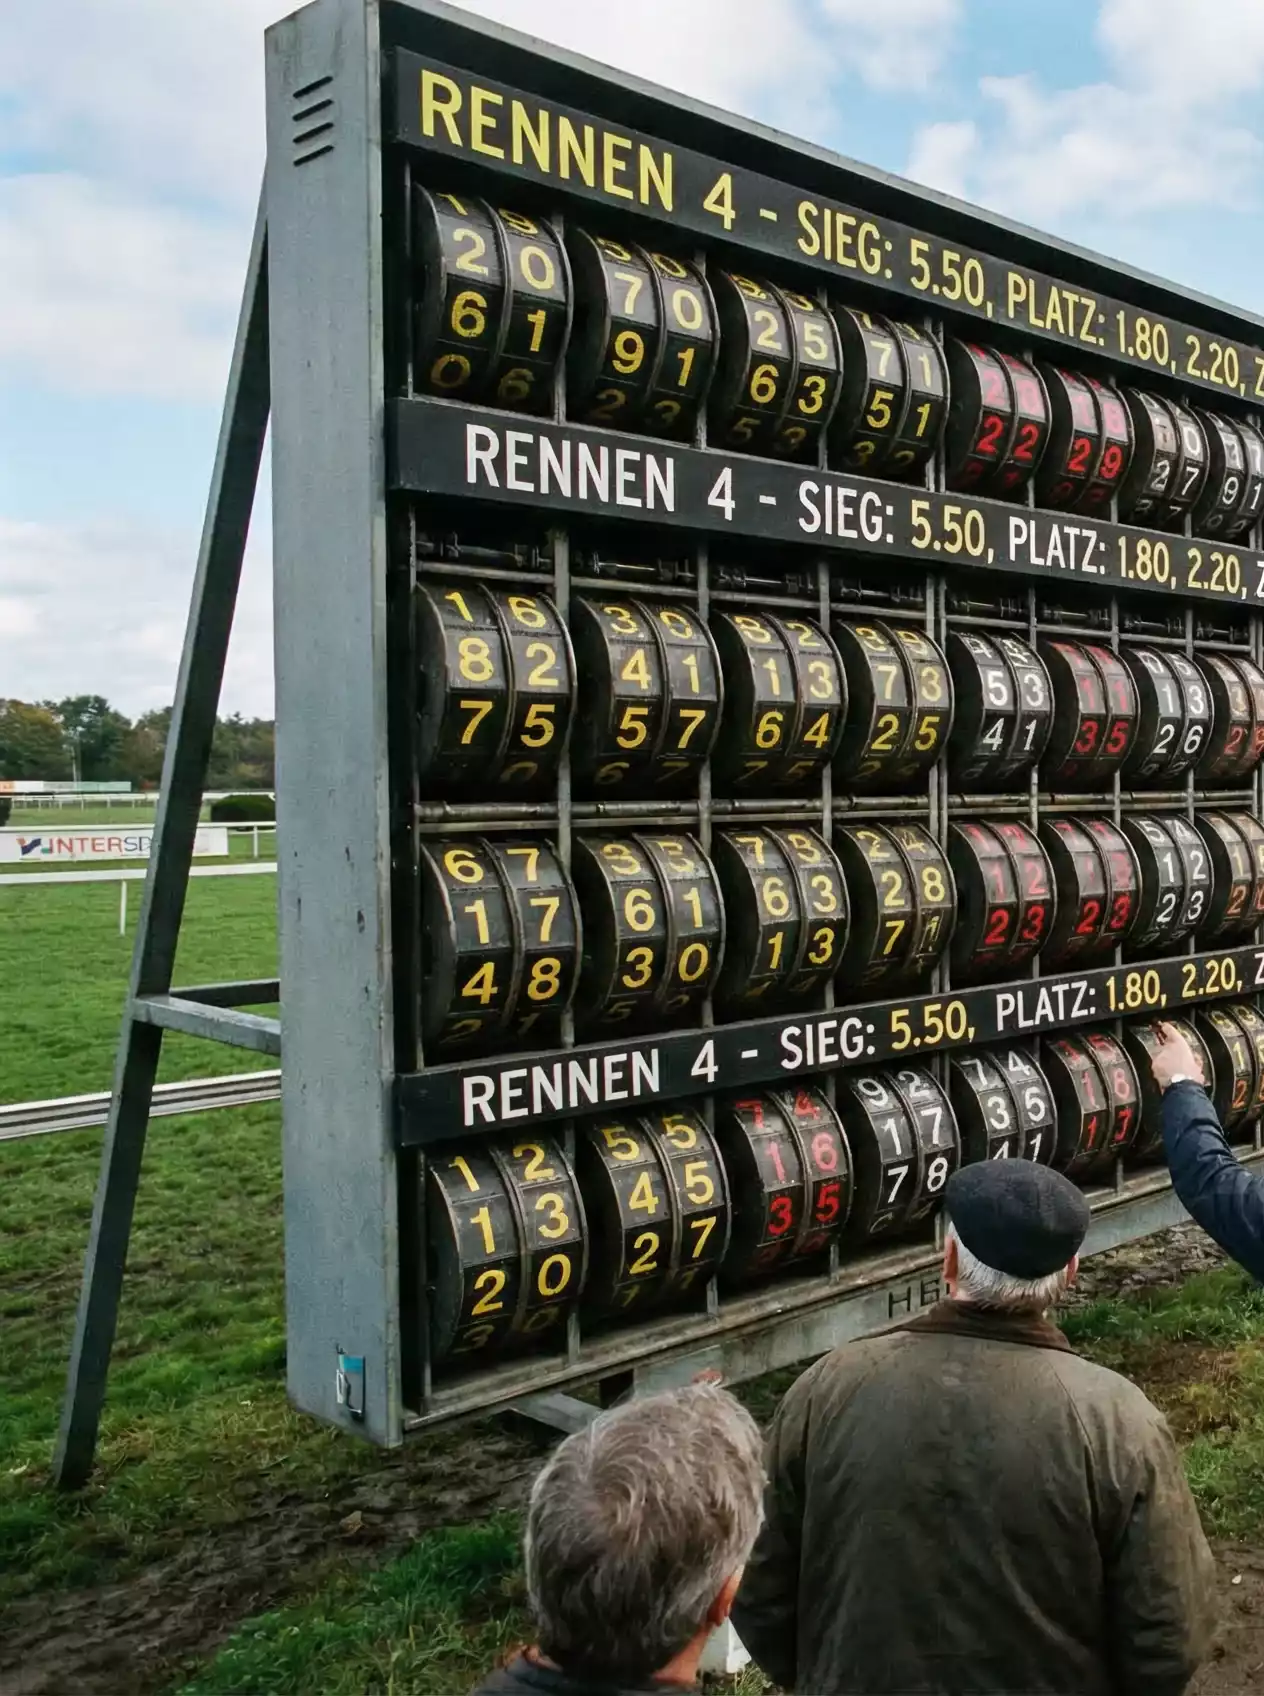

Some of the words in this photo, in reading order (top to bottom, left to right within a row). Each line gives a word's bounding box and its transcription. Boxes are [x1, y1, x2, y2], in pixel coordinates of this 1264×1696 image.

[421, 69, 673, 212] RENNEN
[703, 172, 735, 230] 4
[759, 206, 778, 222] -
[798, 201, 892, 279] SIEG:
[910, 238, 993, 318] 5.50,
[1008, 271, 1105, 346] PLATZ:
[1116, 310, 1176, 374] 1.80,
[1186, 335, 1246, 397] 2.20,
[466, 423, 674, 512] RENNEN
[707, 466, 736, 521] 4
[759, 494, 777, 506] -
[798, 480, 894, 544] SIEG:
[911, 499, 994, 564] 5.50,
[1009, 516, 1106, 575] PLATZ:
[1118, 535, 1177, 590] 1.80,
[1187, 547, 1248, 600] 2.20,
[463, 1048, 660, 1126] RENNEN
[690, 1039, 719, 1083] 4
[741, 1049, 758, 1059] -
[780, 1017, 876, 1070] SIEG:
[890, 1000, 975, 1050] 5.50,
[996, 980, 1096, 1032] PLATZ:
[1106, 970, 1167, 1011] 1.80,
[1181, 957, 1242, 999] 2.20,
